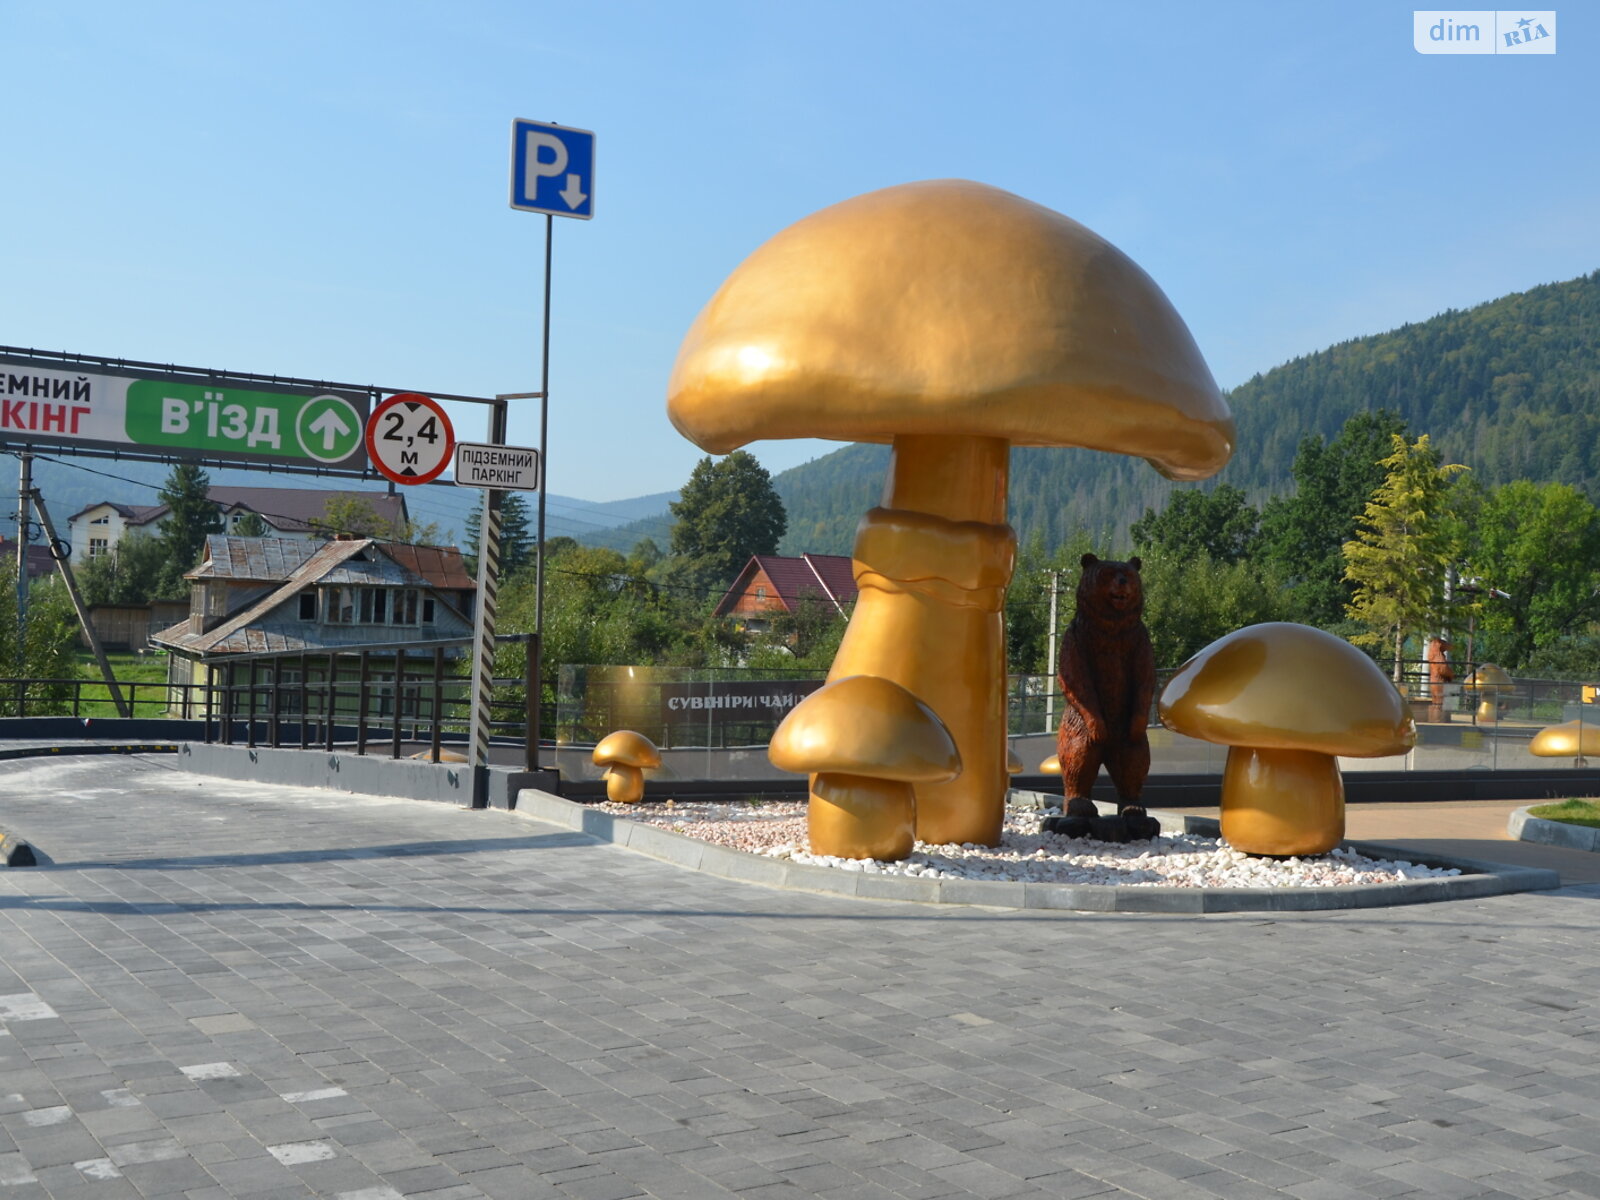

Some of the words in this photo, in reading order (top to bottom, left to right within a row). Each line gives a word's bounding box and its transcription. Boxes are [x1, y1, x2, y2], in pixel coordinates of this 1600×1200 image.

[524, 130, 569, 201] P
[1, 399, 91, 435] КІНГ
[161, 391, 281, 450] В'ЇЗД
[383, 412, 438, 447] 2,4
[462, 450, 533, 468] ПІДЗЕМНИЙ
[471, 467, 522, 484] ПАРКІНГ
[761, 692, 793, 708] ЧАЙ
